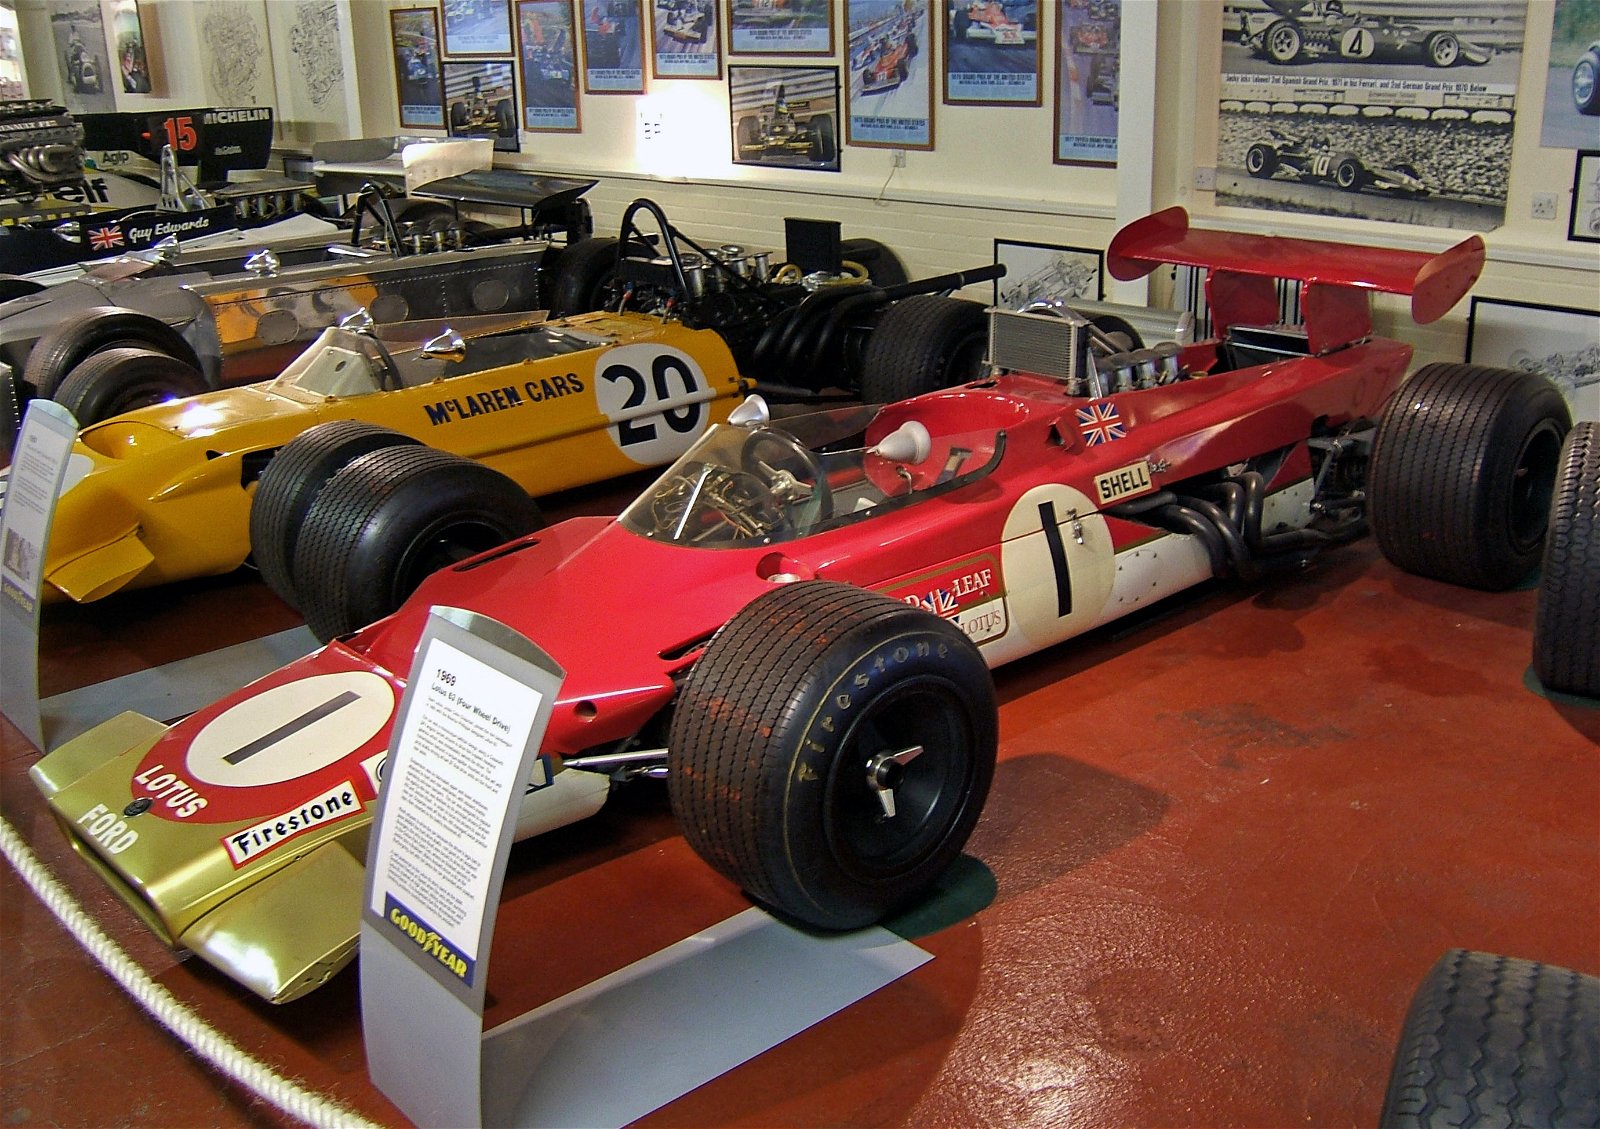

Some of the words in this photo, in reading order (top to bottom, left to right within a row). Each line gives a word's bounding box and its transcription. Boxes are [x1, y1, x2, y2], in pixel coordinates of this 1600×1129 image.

[1349, 30, 1363, 55] 4
[204, 109, 270, 125] MICHELIN
[163, 116, 198, 150] 15
[102, 151, 129, 165] Agip
[53, 178, 109, 203] elf
[128, 227, 153, 243] Guy
[154, 216, 209, 236] Edwards
[525, 372, 585, 403] CARS
[602, 354, 701, 447] 20
[1100, 467, 1149, 499] SHELL
[1038, 501, 1073, 618] 1
[952, 568, 992, 597] LEAF
[436, 668, 457, 687] 1969
[473, 705, 492, 722] Wheel
[492, 716, 511, 735] Drive)
[133, 764, 208, 818] LOTUS
[76, 803, 139, 855] FORD
[231, 788, 354, 857] Firestone
[389, 907, 469, 979] GOODYEAR
